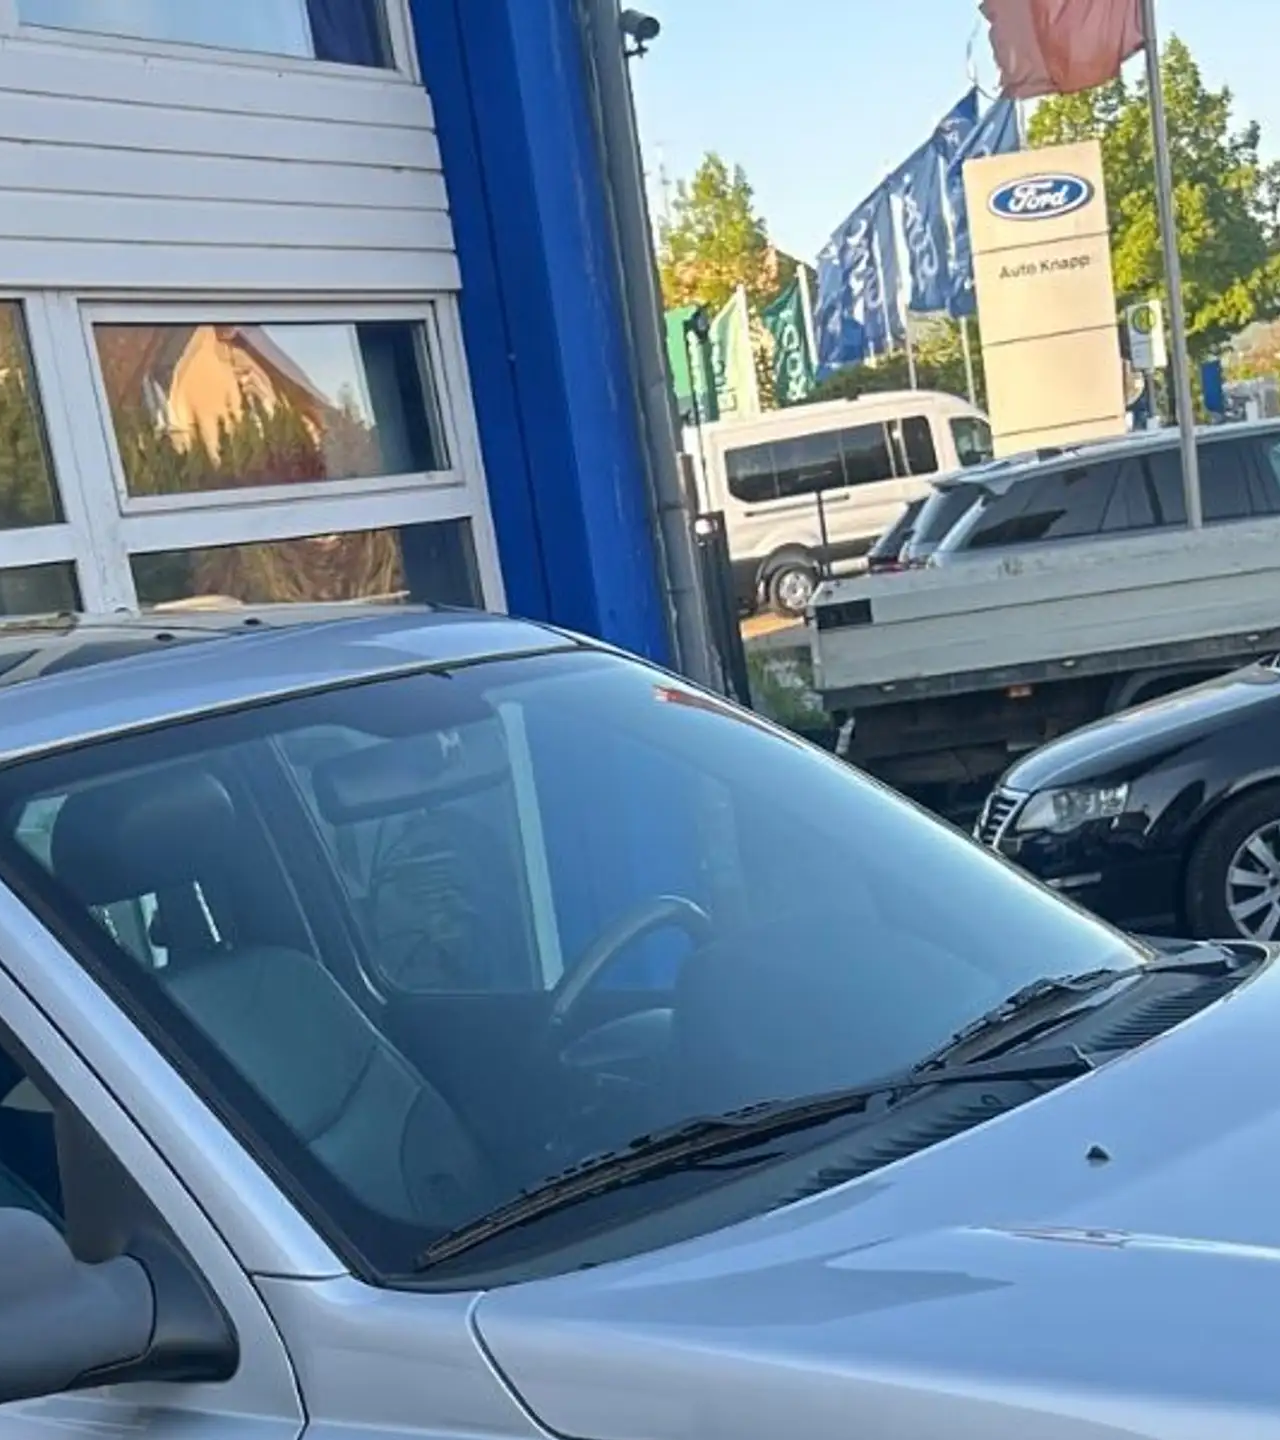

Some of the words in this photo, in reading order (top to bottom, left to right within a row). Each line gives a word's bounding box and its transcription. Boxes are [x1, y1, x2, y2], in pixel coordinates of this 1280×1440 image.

[1007, 180, 1070, 213] Ford
[999, 263, 1038, 279] Auto
[1040, 254, 1091, 274] Knapp
